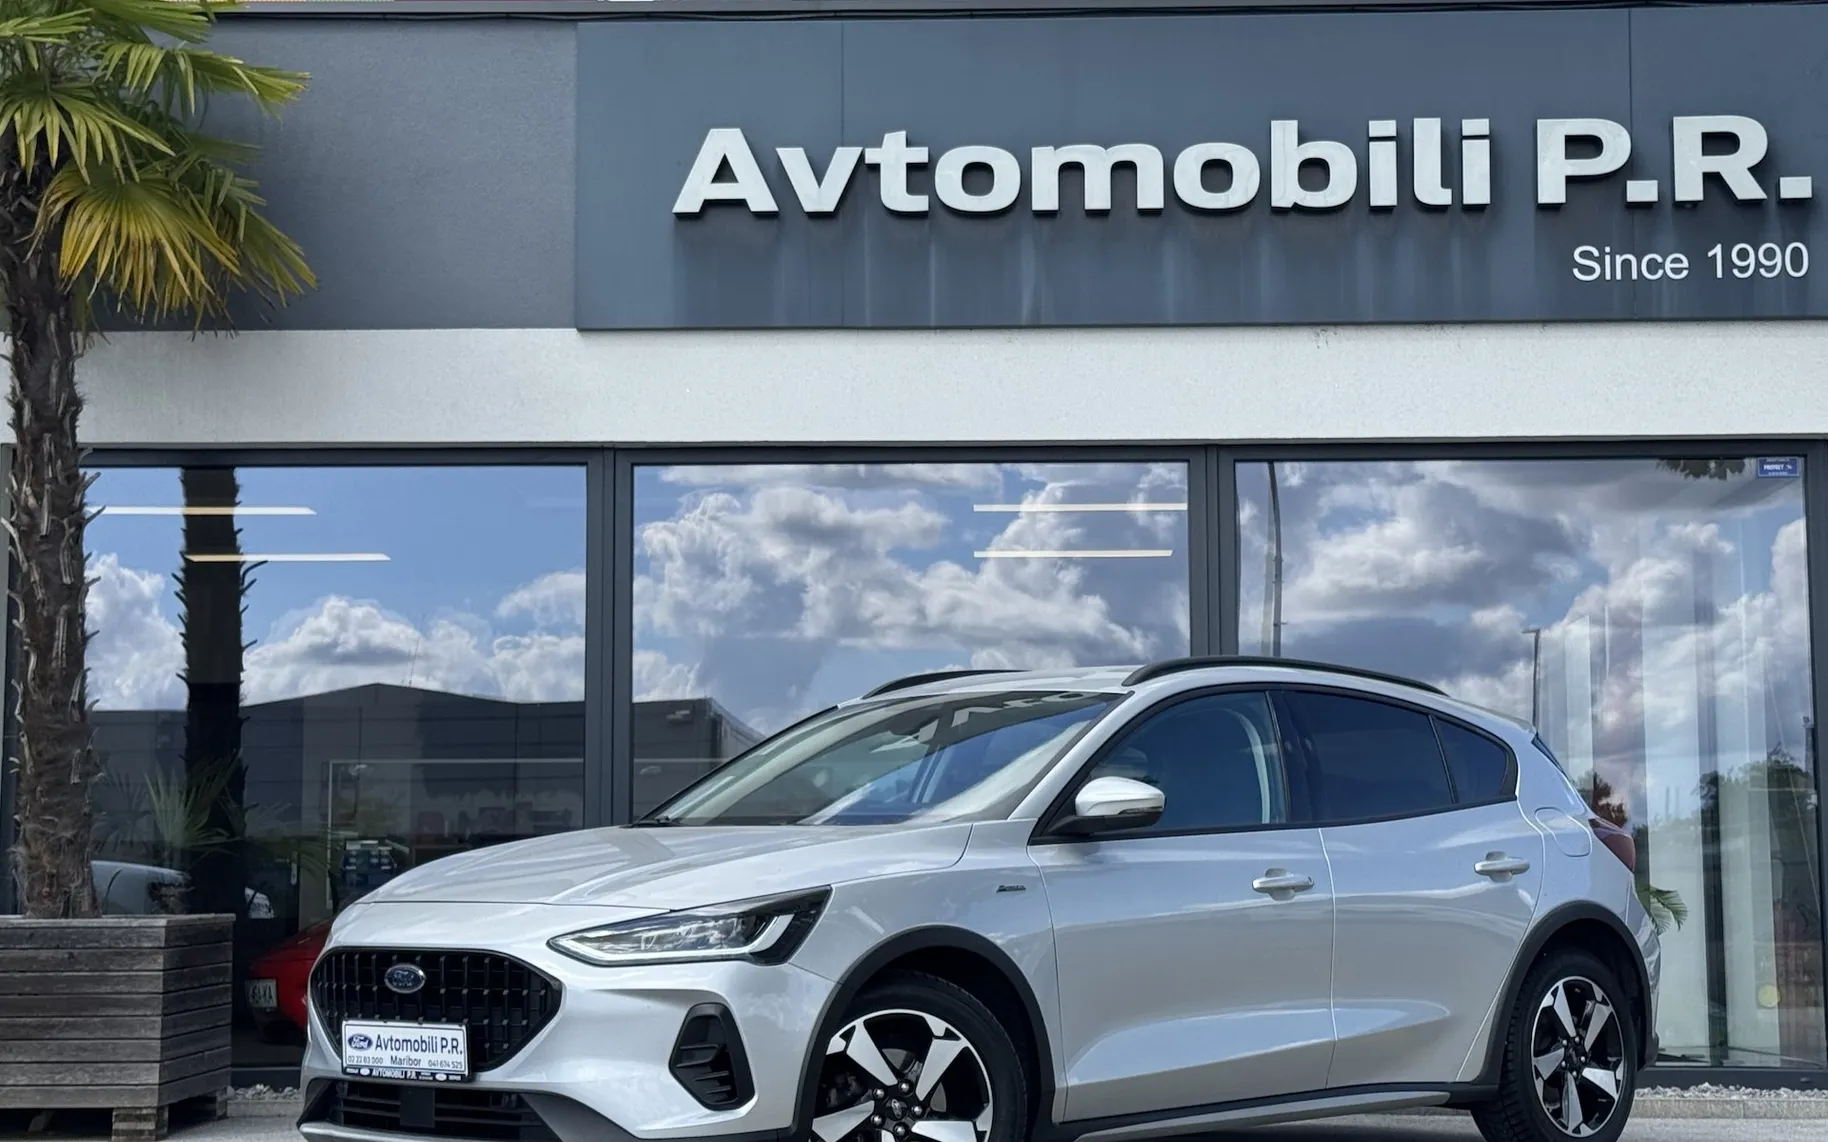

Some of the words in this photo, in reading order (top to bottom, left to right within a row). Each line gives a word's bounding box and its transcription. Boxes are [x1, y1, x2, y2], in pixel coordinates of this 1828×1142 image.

[672, 117, 1492, 214] Avtomobili
[1536, 115, 1813, 206] P.R.
[1572, 244, 1690, 282] Since
[1706, 241, 1810, 279] 1990
[375, 1034, 438, 1053] Avtomobili
[440, 1036, 463, 1055] P.R.
[390, 1055, 422, 1067] Maribor
